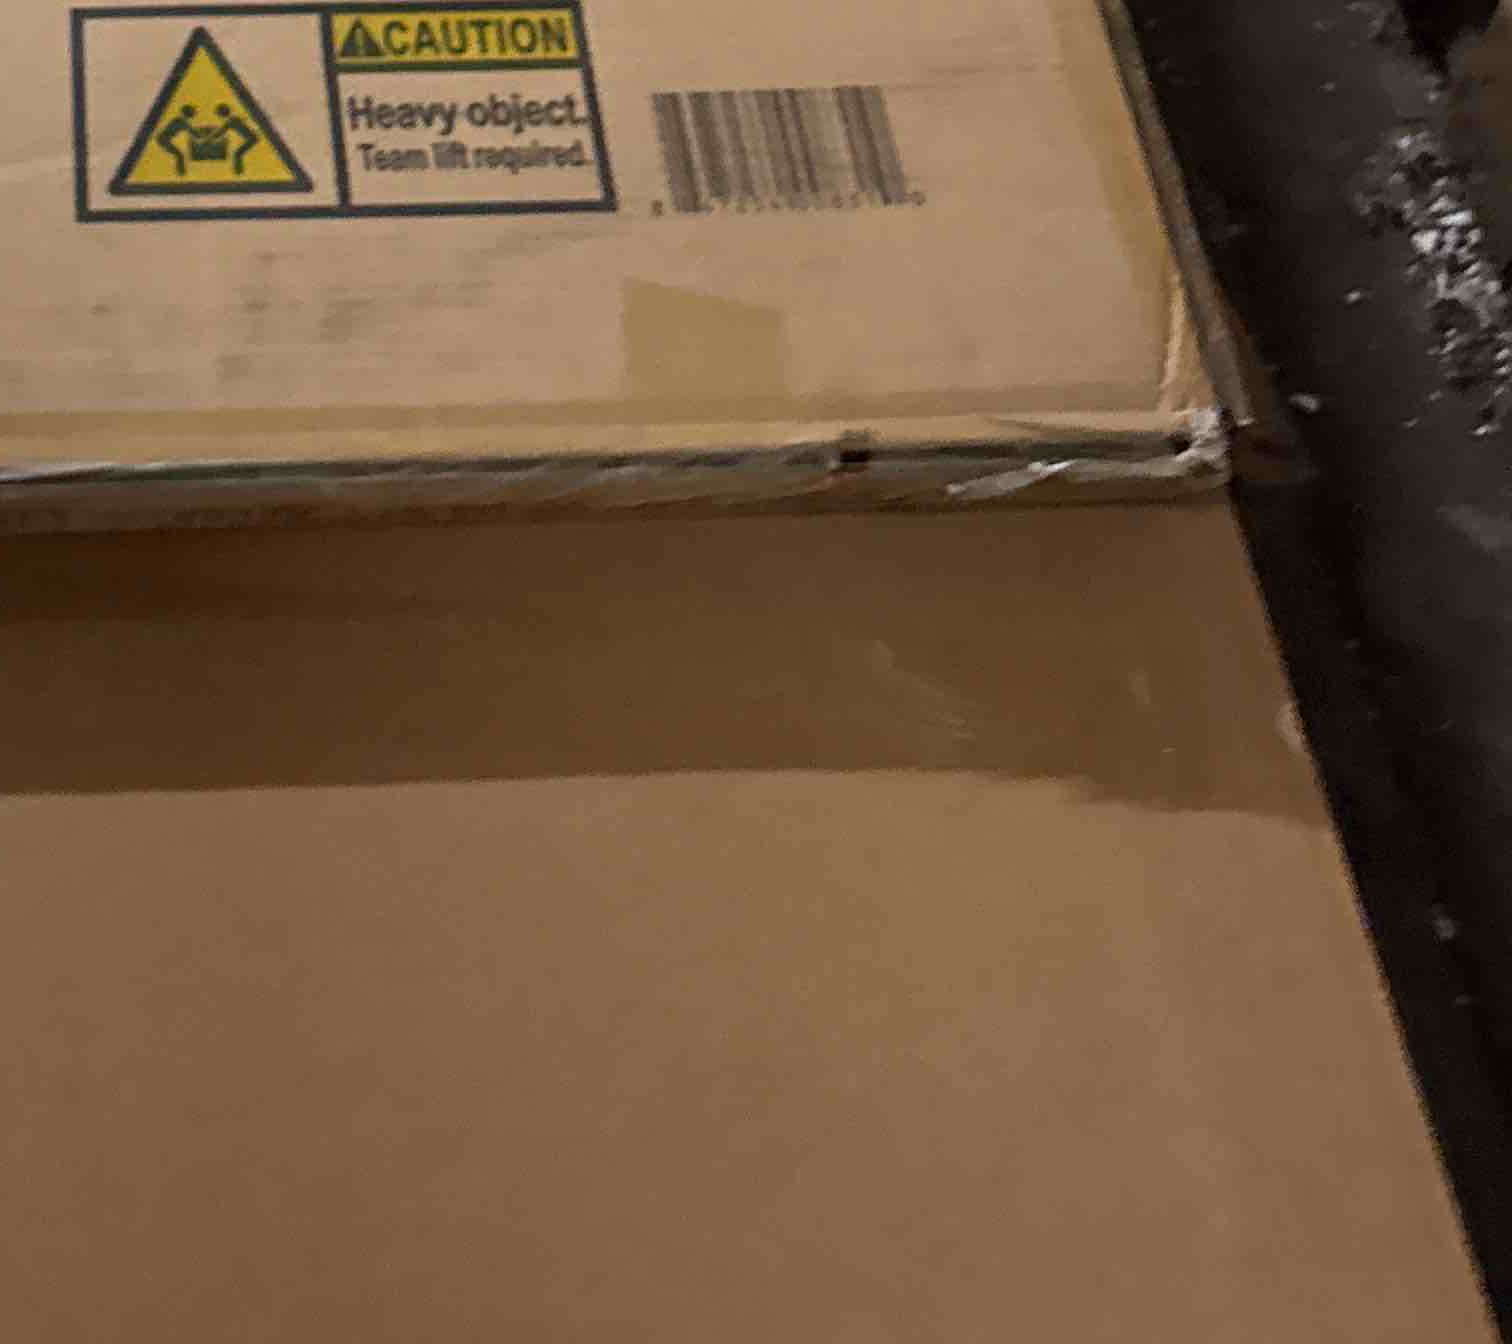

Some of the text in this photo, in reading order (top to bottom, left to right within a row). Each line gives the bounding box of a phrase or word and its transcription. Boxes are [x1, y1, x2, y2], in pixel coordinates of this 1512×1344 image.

[381, 16, 569, 56] CAUTION
[347, 95, 458, 137] Heavy
[356, 143, 430, 172] Team
